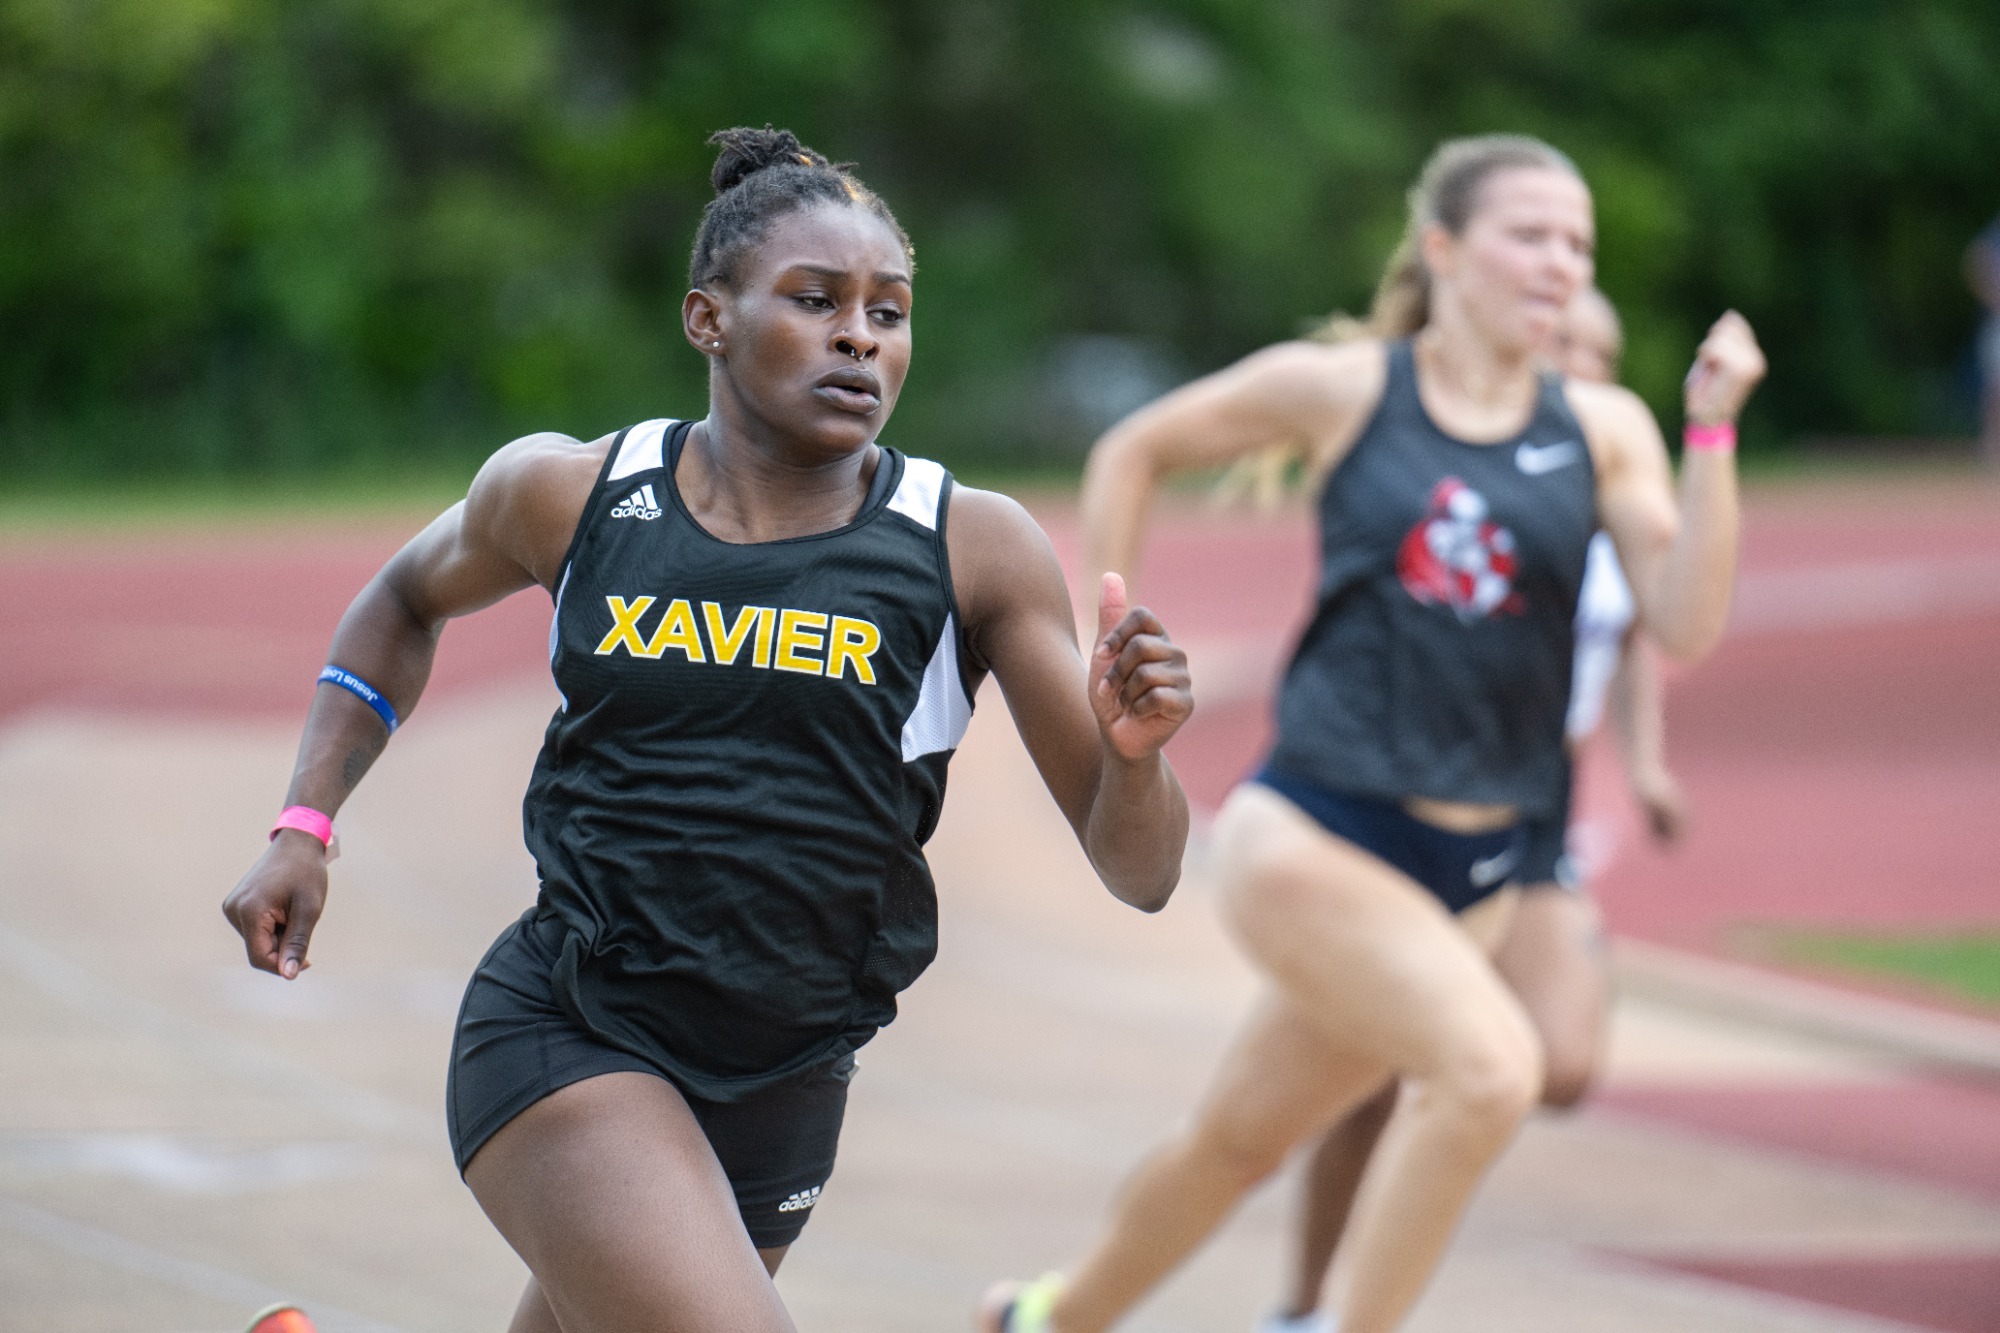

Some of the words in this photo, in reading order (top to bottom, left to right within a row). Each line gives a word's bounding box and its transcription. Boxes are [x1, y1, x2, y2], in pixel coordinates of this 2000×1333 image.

[610, 504, 663, 521] adidas
[593, 595, 882, 686] XAVIER
[343, 674, 378, 702] Jesus
